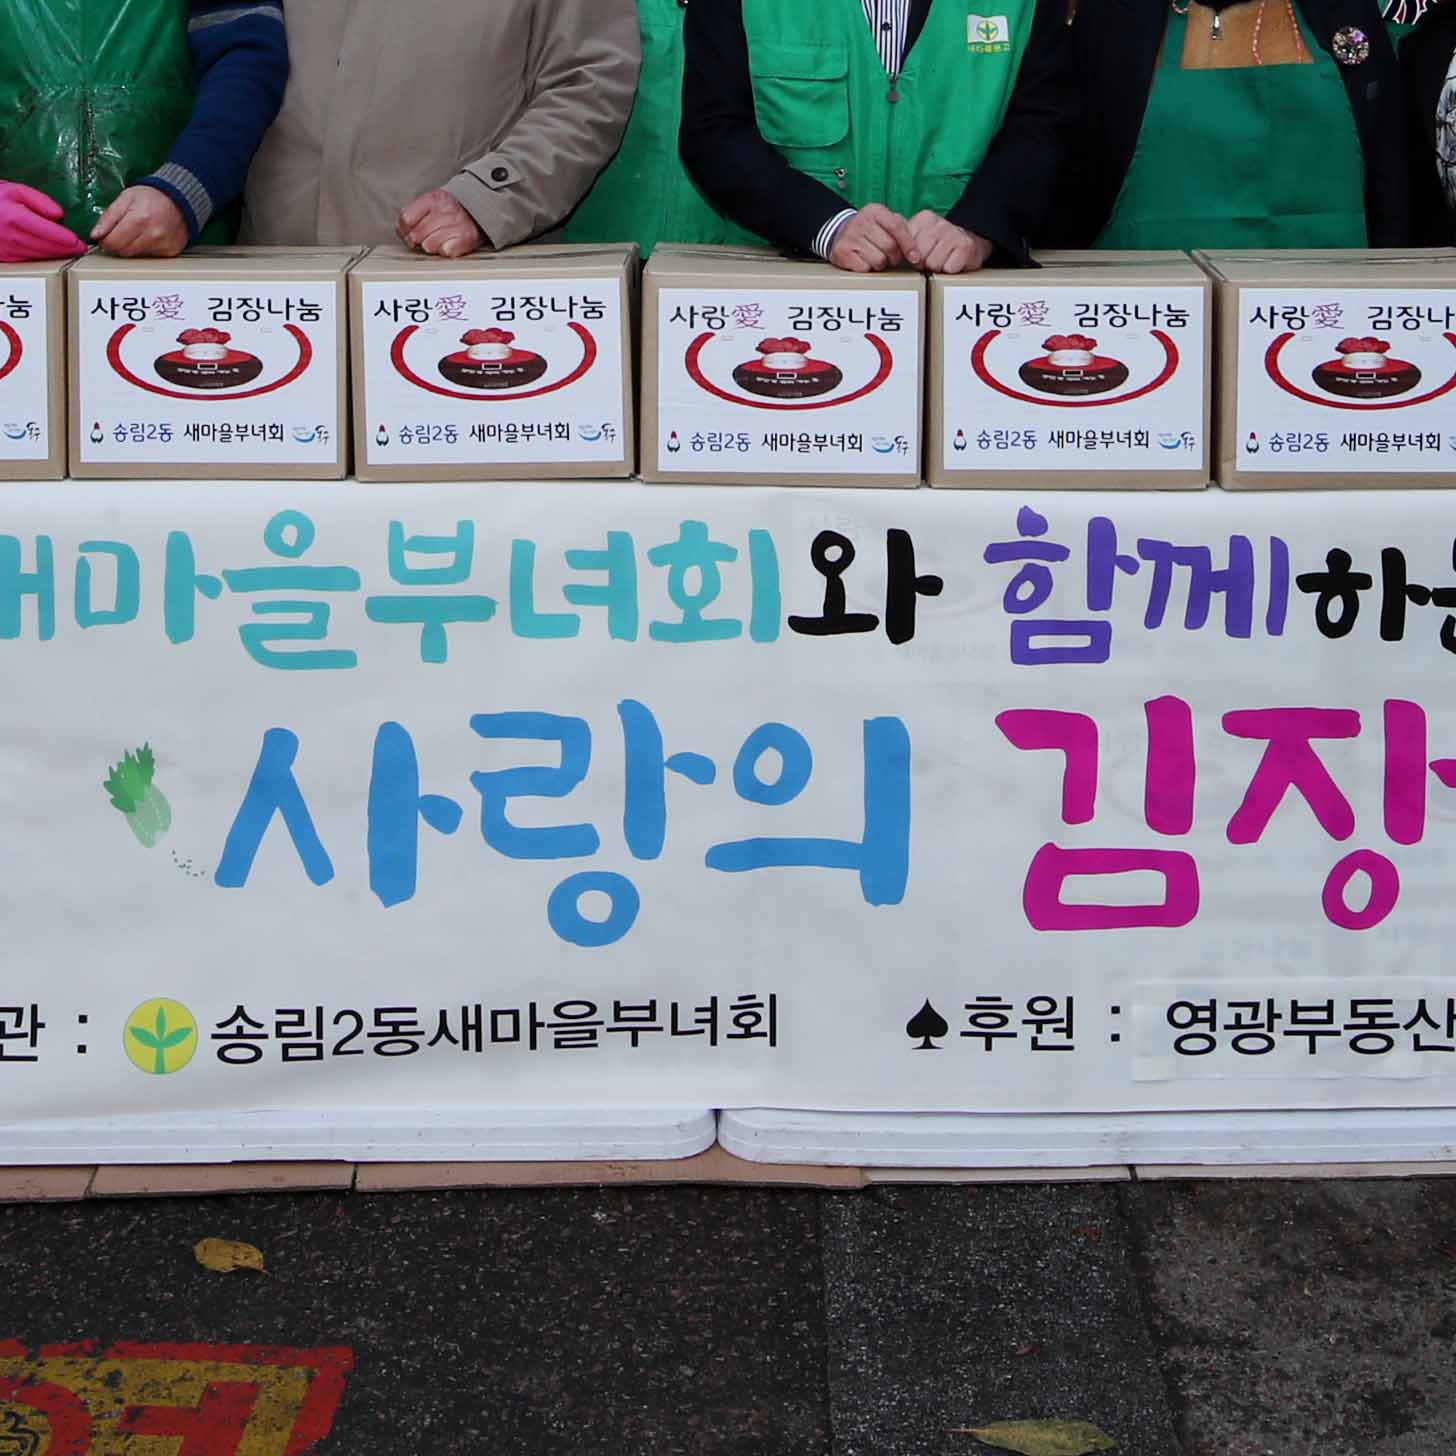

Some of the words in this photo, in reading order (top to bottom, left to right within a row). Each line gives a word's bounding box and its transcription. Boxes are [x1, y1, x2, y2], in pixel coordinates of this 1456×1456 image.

[91, 294, 184, 322] 사랑愛
[208, 297, 323, 322] 김장나눔
[374, 295, 468, 323] 사랑愛
[491, 296, 606, 323] 김장나눔
[670, 303, 765, 330] 사랑愛
[788, 306, 904, 331] 김장나눔
[955, 301, 1050, 328] 사랑愛
[1074, 304, 1190, 328] 김장나눔
[1250, 303, 1344, 330] 사랑愛
[113, 423, 173, 443] 송림2동
[184, 423, 283, 443] 새마을부녀회
[399, 424, 458, 444] 송림2동
[469, 422, 569, 443] 새마을부녀회
[690, 432, 751, 452] 송림2동
[762, 433, 862, 453] 새마을부녀회
[977, 430, 1037, 449] 송림2동
[1048, 429, 1149, 450] 새마을부녀회
[1269, 433, 1329, 452] 송림2동
[1340, 432, 1440, 453] 새마을부녀회
[215, 699, 910, 947] 사랑의
[211, 994, 776, 1064] 송림2동새마을부녀회
[960, 996, 1074, 1051] 후원
